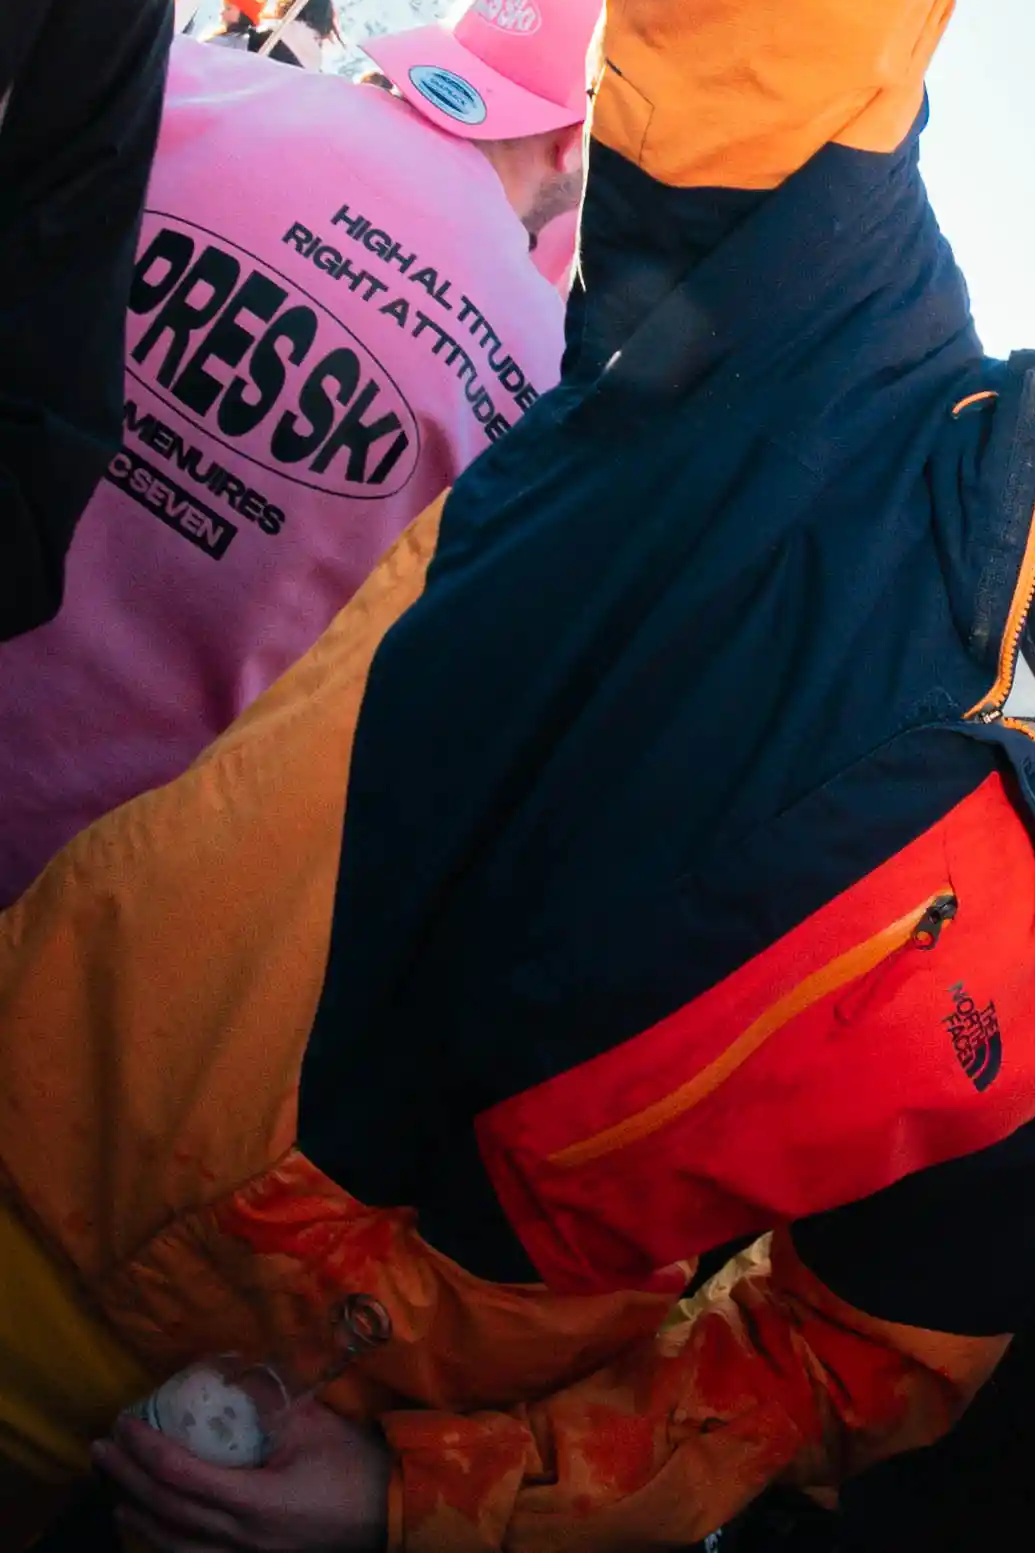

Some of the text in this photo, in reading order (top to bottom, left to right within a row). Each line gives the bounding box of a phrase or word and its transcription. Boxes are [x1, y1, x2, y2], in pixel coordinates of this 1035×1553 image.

[282, 221, 512, 443] RIGHT ATTITUDE
[331, 204, 541, 413] HIGH ALTITUDE
[122, 399, 287, 536] MENUIRES
[270, 347, 410, 485] SKI
[130, 465, 225, 549] SEVEN
[941, 1012, 975, 1062] FACE
[948, 980, 988, 1052] NORTH
[979, 999, 1001, 1040] THE
